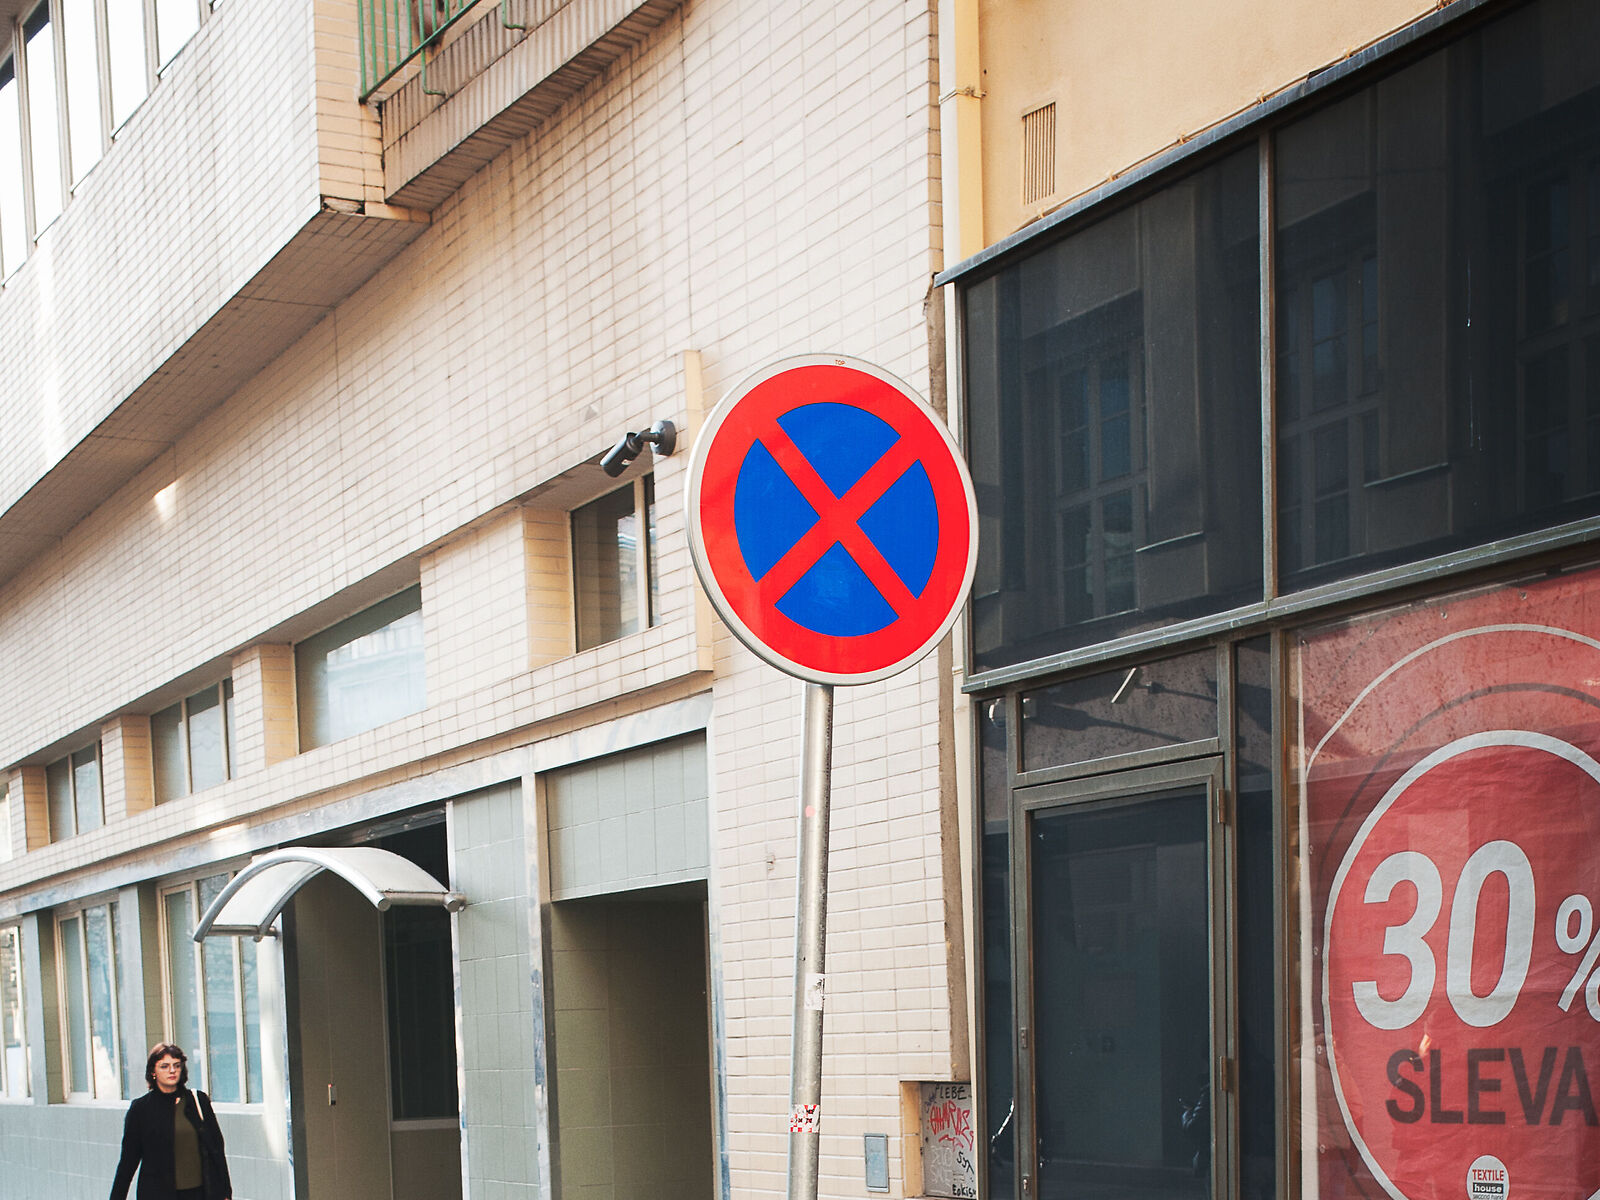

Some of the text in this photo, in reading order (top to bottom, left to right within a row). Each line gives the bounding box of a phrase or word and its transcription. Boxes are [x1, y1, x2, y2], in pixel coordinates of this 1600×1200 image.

[1352, 839, 1536, 1031] 30
[1385, 1046, 1600, 1127] SLEVA
[1472, 1169, 1504, 1181] TEXTILE
[1474, 1183, 1502, 1193] house
